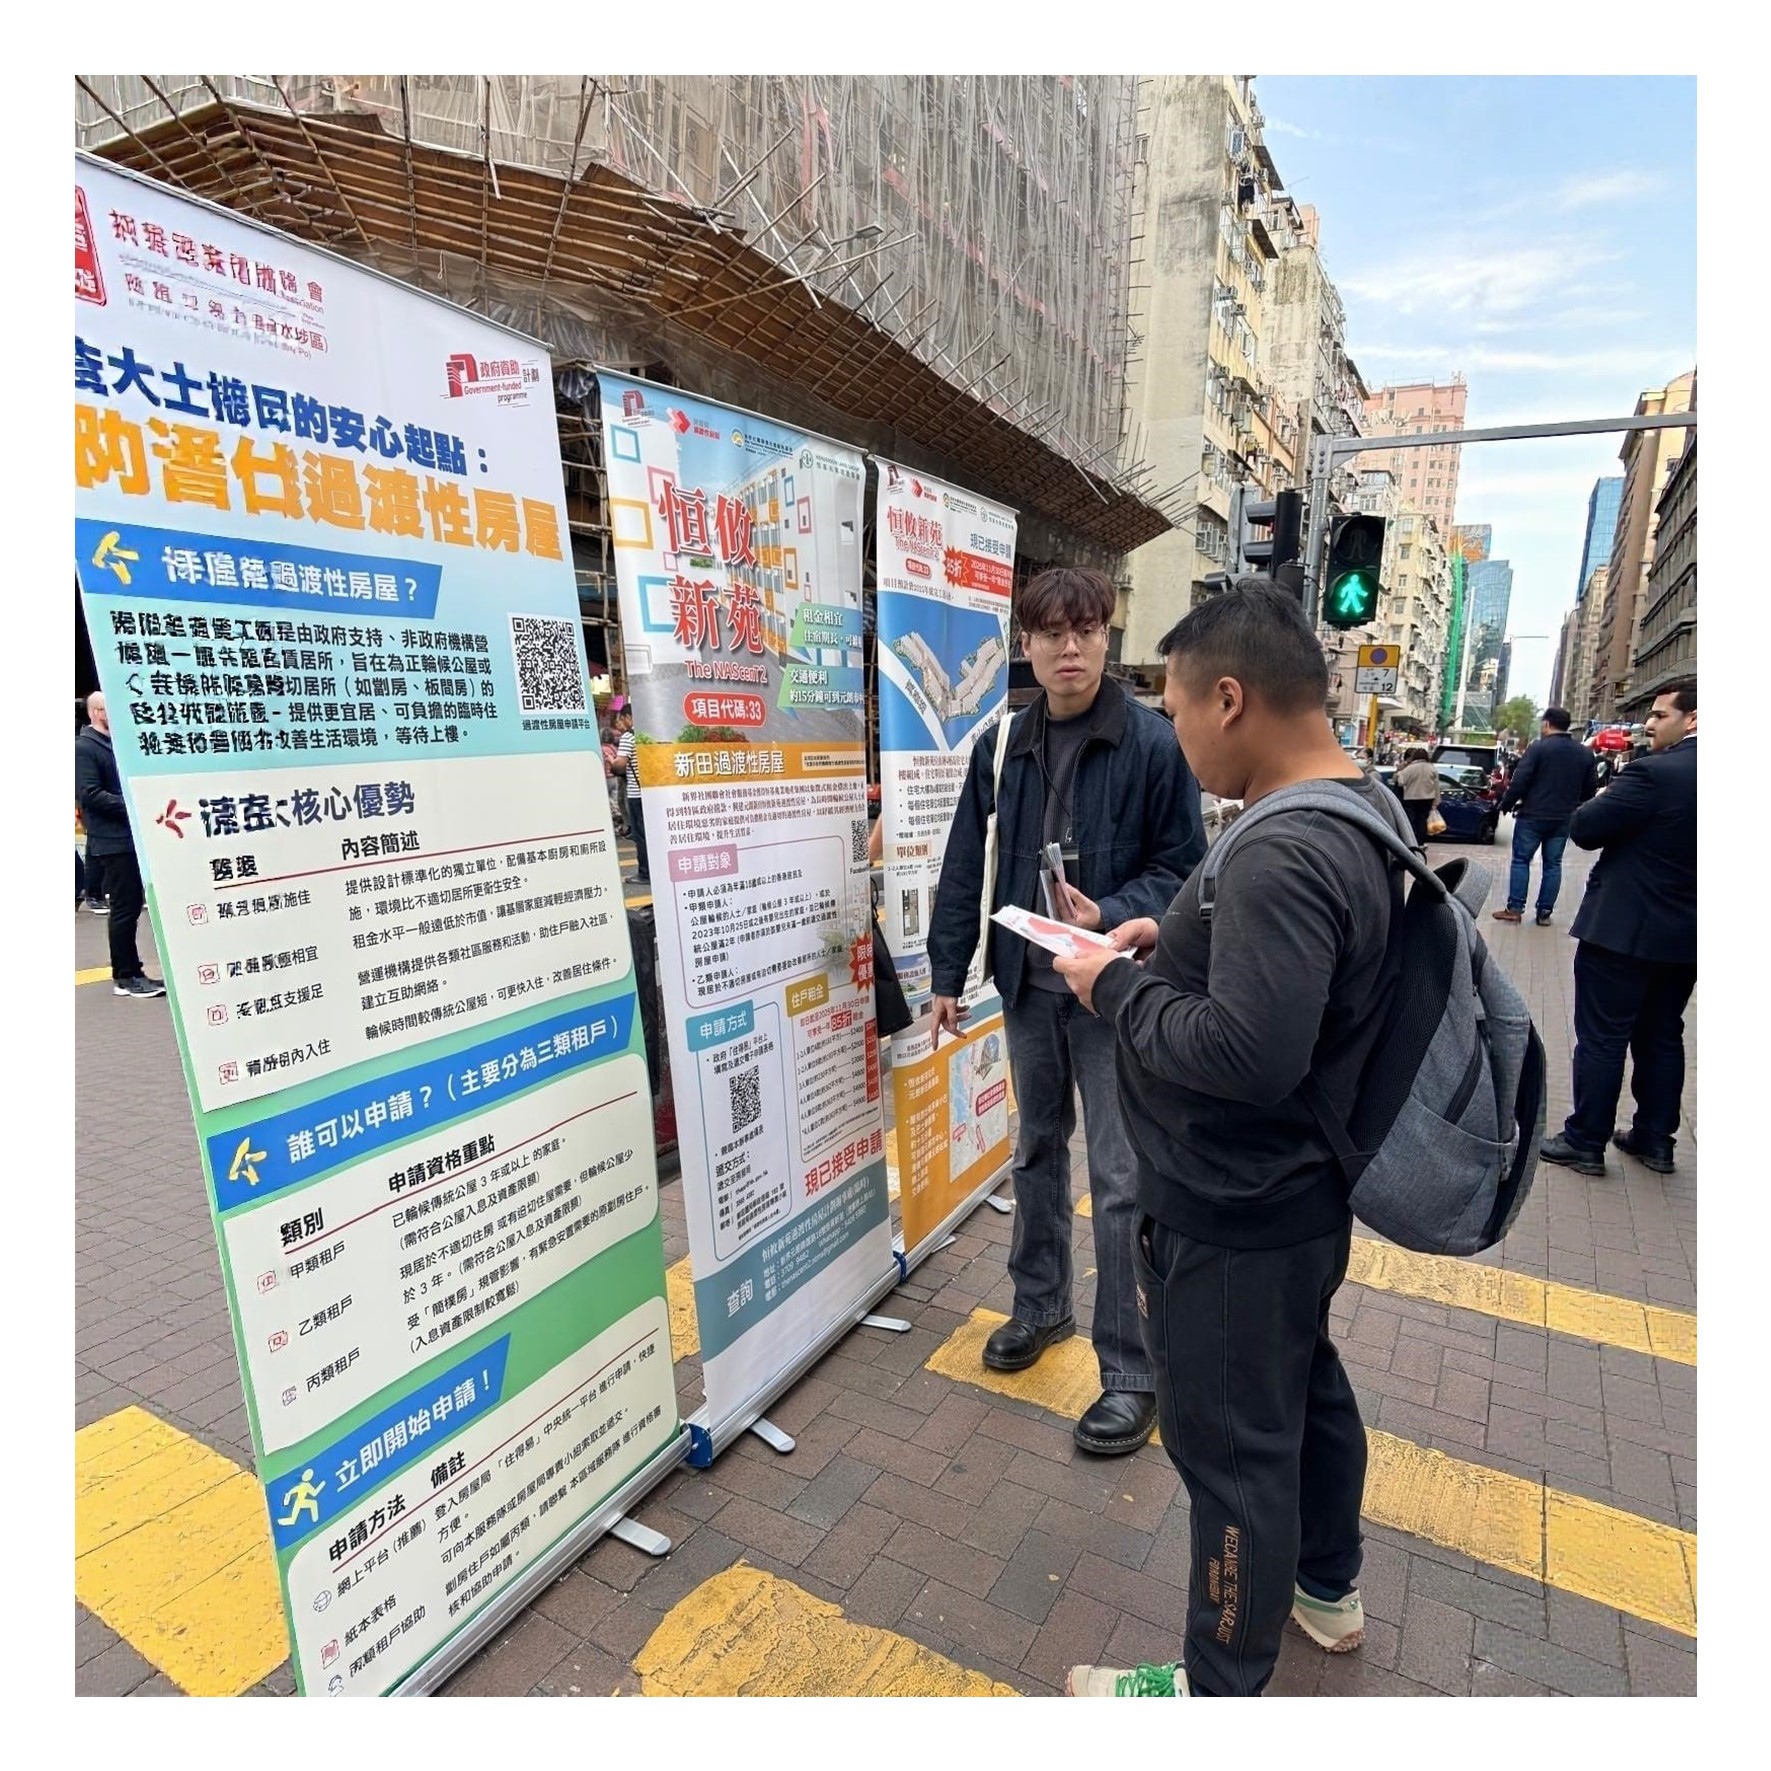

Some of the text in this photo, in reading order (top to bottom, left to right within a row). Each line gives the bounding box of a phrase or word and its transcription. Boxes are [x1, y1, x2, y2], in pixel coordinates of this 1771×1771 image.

[480, 361, 539, 383] 政府資助 計劃
[464, 381, 522, 396] Government-funded
[497, 391, 528, 403] programme
[75, 336, 488, 475] 大土的安心起點：
[75, 403, 563, 562] 過渡性房屋
[668, 574, 764, 654] 新苑
[803, 609, 843, 626] 租金相宜
[685, 659, 712, 679] The
[790, 669, 828, 685] 交通便利
[1383, 669, 1389, 677] 7
[1382, 682, 1393, 691] 12
[522, 718, 590, 731] 過渡性房屋申請平台
[674, 750, 784, 777] 新田過渡性房屋
[199, 780, 414, 838] 核心優勢
[341, 830, 420, 861] 內容簡述
[678, 851, 732, 874] 申請對象
[361, 979, 448, 1011] 建立互助網絡。
[792, 984, 824, 1008] 住戶租金
[700, 1010, 747, 1038] 申請方式
[388, 1133, 495, 1194] 申請資格重點
[804, 1128, 883, 1197] 現已接受申請
[392, 1182, 477, 1228] 已輪候傳統公屋
[481, 1176, 487, 1188] 3
[290, 1241, 345, 1279] 甲類租戶
[727, 1278, 753, 1318] 查詢
[298, 1295, 353, 1337] 乙類租戶
[306, 1347, 360, 1392] 丙類租戶
[334, 1369, 490, 1493] 立即開始申請！
[328, 1450, 466, 1562] 申請方法 備註
[437, 1511, 469, 1543] 方便。
[344, 1594, 397, 1647] 紙本表格
